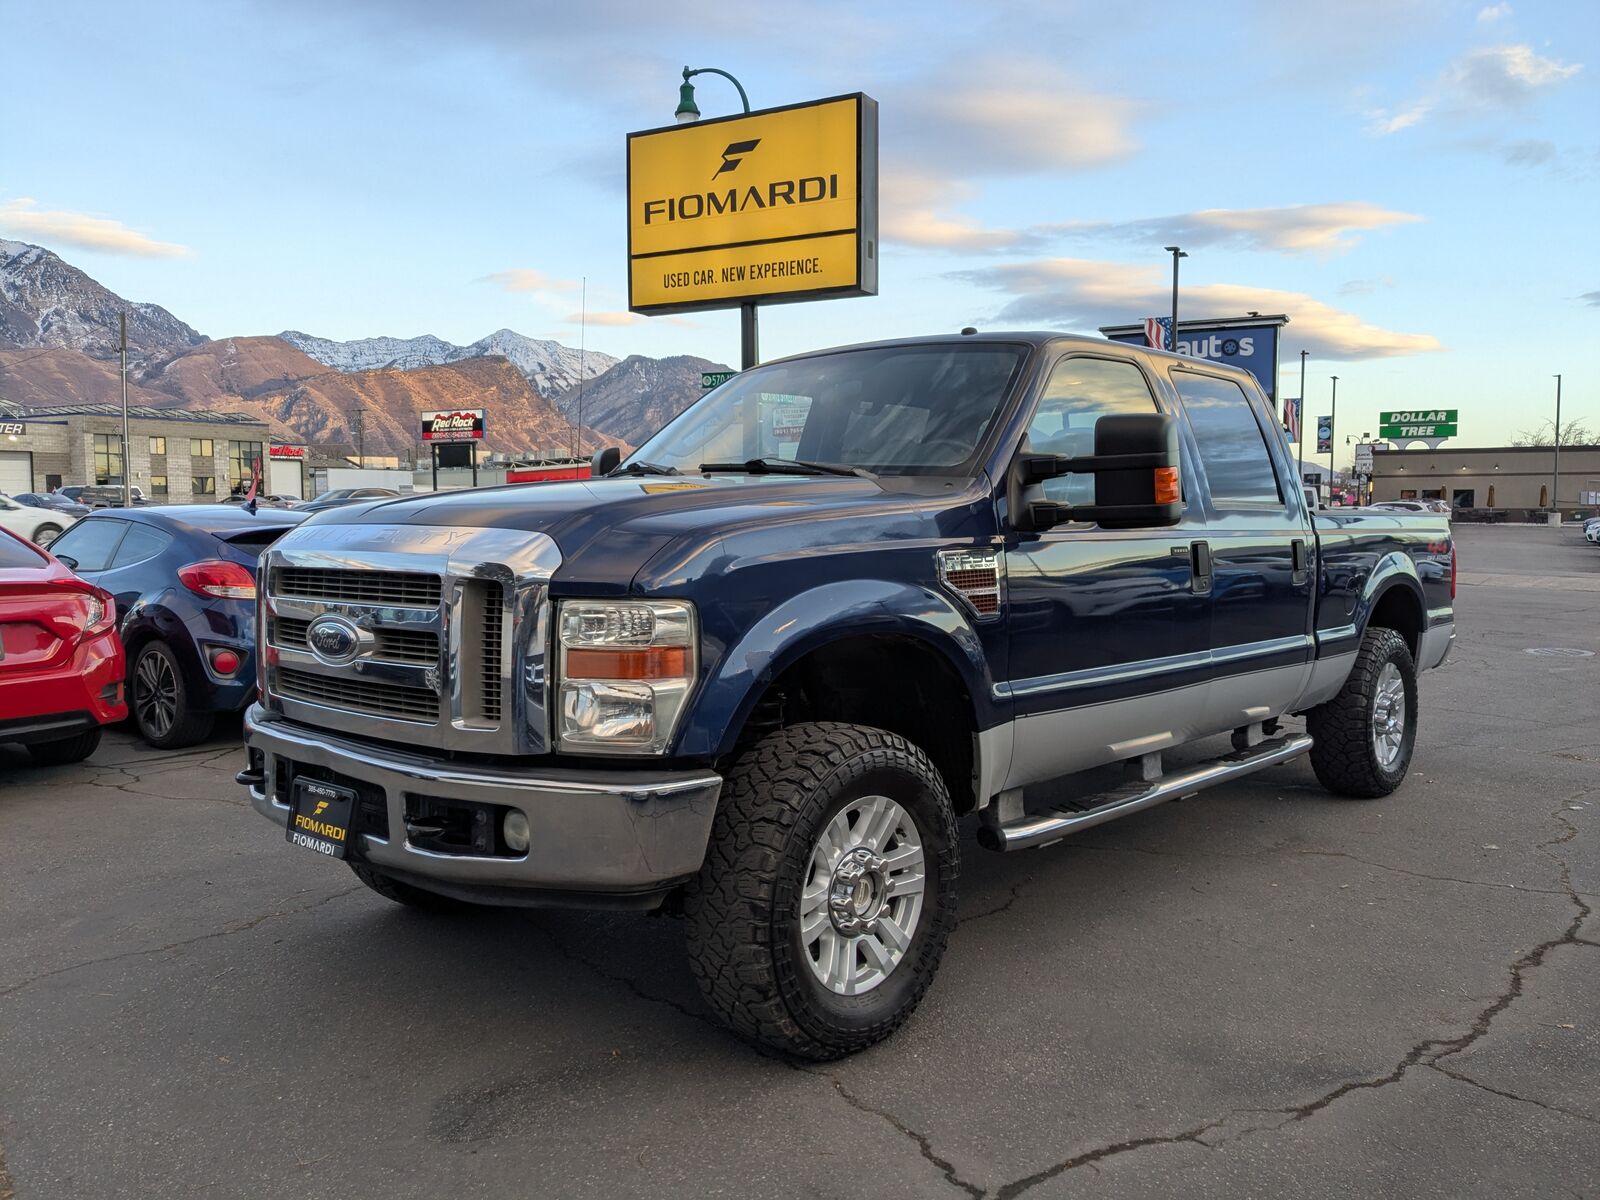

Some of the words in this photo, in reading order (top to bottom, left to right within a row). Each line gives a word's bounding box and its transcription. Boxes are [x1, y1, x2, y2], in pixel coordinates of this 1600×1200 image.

[644, 174, 838, 225] FIOMARDI
[663, 271, 690, 289] USED
[693, 269, 718, 286] CAR.
[721, 266, 746, 283] NEW
[750, 257, 823, 281] EXPERIENCE.
[431, 417, 452, 432] Red
[451, 415, 475, 428] Rock
[1390, 411, 1447, 423] DOLLAR
[1400, 425, 1436, 437] TREE
[316, 631, 341, 650] Ford
[295, 814, 346, 841] FIOMARDI
[292, 832, 335, 856] FIOMARDI
